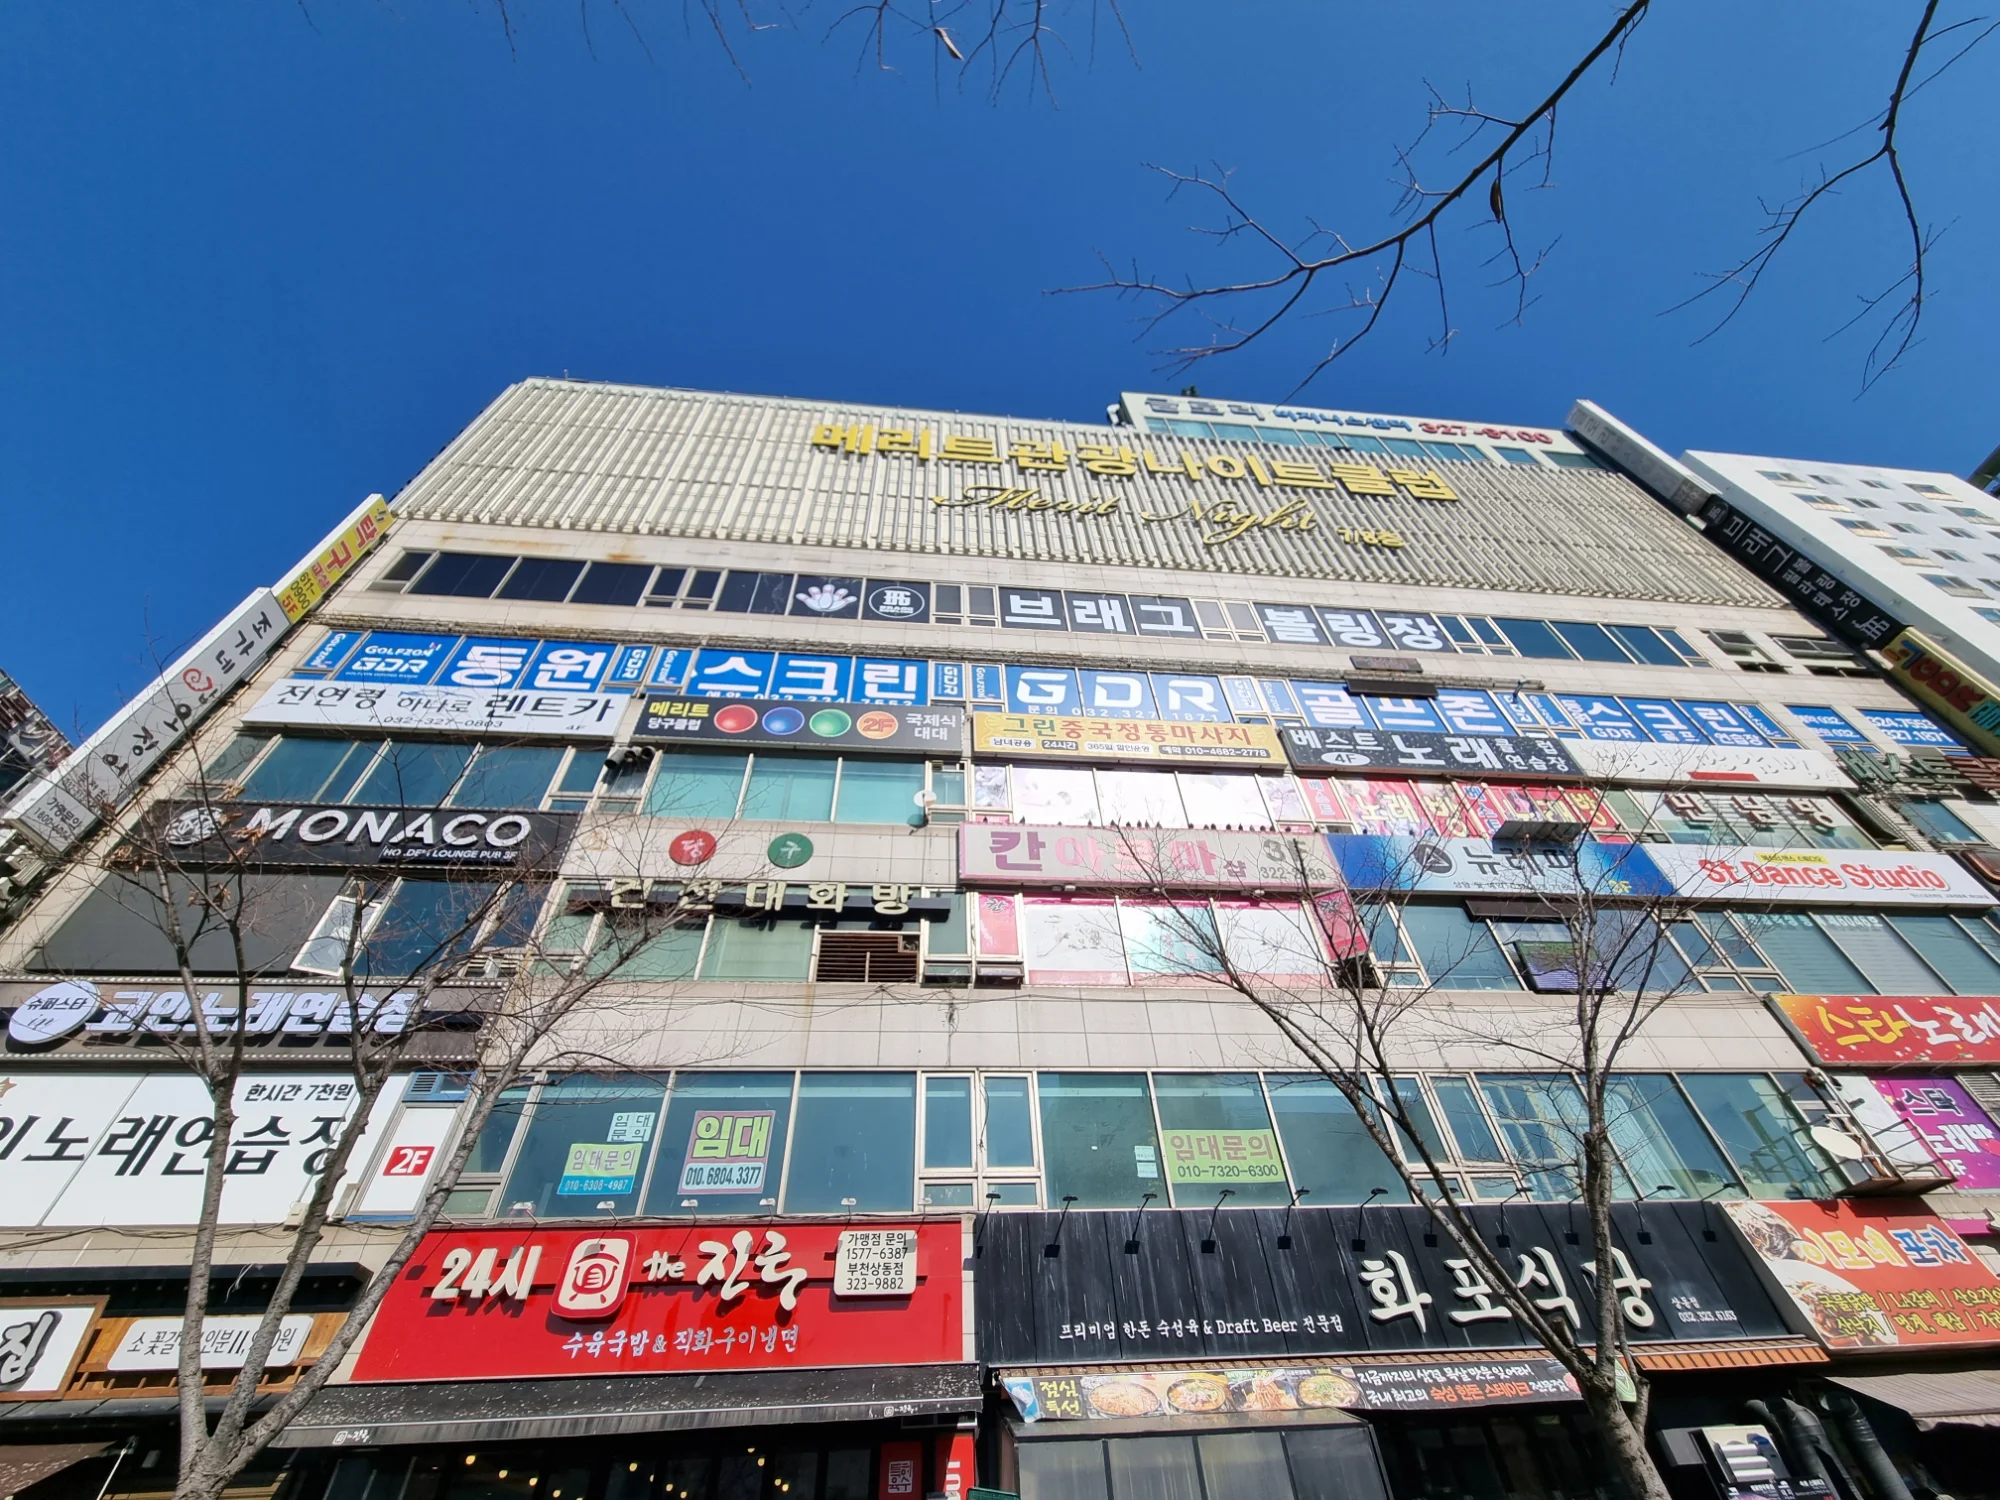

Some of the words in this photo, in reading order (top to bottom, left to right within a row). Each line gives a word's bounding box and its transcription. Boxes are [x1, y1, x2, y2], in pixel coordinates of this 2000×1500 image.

[812, 424, 1458, 500] 메리트관광나이트클럽
[934, 485, 1120, 514] Merit
[1141, 500, 1317, 544] Night
[282, 595, 298, 614] 5F
[1005, 593, 1195, 634] 브래그
[1264, 608, 1445, 651] 볼링장
[214, 611, 273, 675] 조가네
[365, 643, 440, 657] GOLFZON
[351, 657, 428, 673] GDR
[450, 645, 606, 691] 동원
[690, 656, 917, 702] 스크린
[943, 666, 958, 695] GDR
[1016, 672, 1218, 712] GDR
[484, 693, 614, 722] 렌트카
[649, 702, 710, 718] 메리트
[1028, 704, 1059, 715] 문의
[1587, 702, 1744, 732] 스크린
[648, 717, 701, 731] 당구클럽
[863, 719, 895, 733] 2F
[906, 713, 956, 728] 국제식
[915, 727, 948, 741] 대대
[1592, 727, 1636, 739] GDR
[1043, 740, 1078, 750] 24시간
[1291, 730, 1384, 750] 베스트
[1390, 734, 1502, 769] 노래
[1335, 752, 1358, 766] 4F
[1505, 754, 1569, 773] 연습장
[243, 808, 532, 847] MONACO
[432, 848, 477, 858] LOUNGE
[1698, 858, 1744, 884] St
[1741, 860, 1845, 888] Dance
[1841, 863, 1949, 891] Studio
[27, 997, 89, 1010] 슈퍼스타
[1816, 1005, 1911, 1046] 스타
[245, 1084, 303, 1101] 한시간
[305, 1084, 355, 1101] 7천원
[616, 1114, 651, 1127] 임대
[611, 1128, 647, 1142] 문의
[692, 1115, 772, 1159] 임대
[1170, 1134, 1274, 1161] 임대문의
[390, 1150, 429, 1174] 2F
[572, 1149, 637, 1171] 임대문의
[685, 1166, 762, 1186] 010.6804.3377
[1177, 1164, 1279, 1178] 010-7320-6300
[847, 1233, 882, 1246] 가맹점
[885, 1232, 907, 1246] 문의
[1889, 1224, 1971, 1267] 포차
[846, 1247, 908, 1261] 1577-6387
[431, 1245, 543, 1300] 24시
[643, 1250, 686, 1281] the
[846, 1262, 904, 1276] 부천상동점
[846, 1277, 904, 1290] 323-9882
[1060, 1320, 1115, 1340] 프리미엄
[1123, 1321, 1151, 1338] 한돈
[1156, 1319, 1199, 1339] 숙성육
[1203, 1320, 1213, 1335] &
[1215, 1319, 1259, 1336] Draft
[1262, 1318, 1298, 1334] Beer
[1303, 1314, 1344, 1334] 전문점
[562, 1329, 650, 1359] 수육국밥
[652, 1333, 667, 1353] &
[1040, 1380, 1079, 1398] 점심
[1366, 1389, 1392, 1407] 국내
[1393, 1388, 1429, 1404] 최고의
[1430, 1385, 1454, 1403] 숙성
[1455, 1384, 1484, 1401] 한돈
[1484, 1382, 1531, 1398] 스테이크
[1045, 1400, 1082, 1417] 특선
